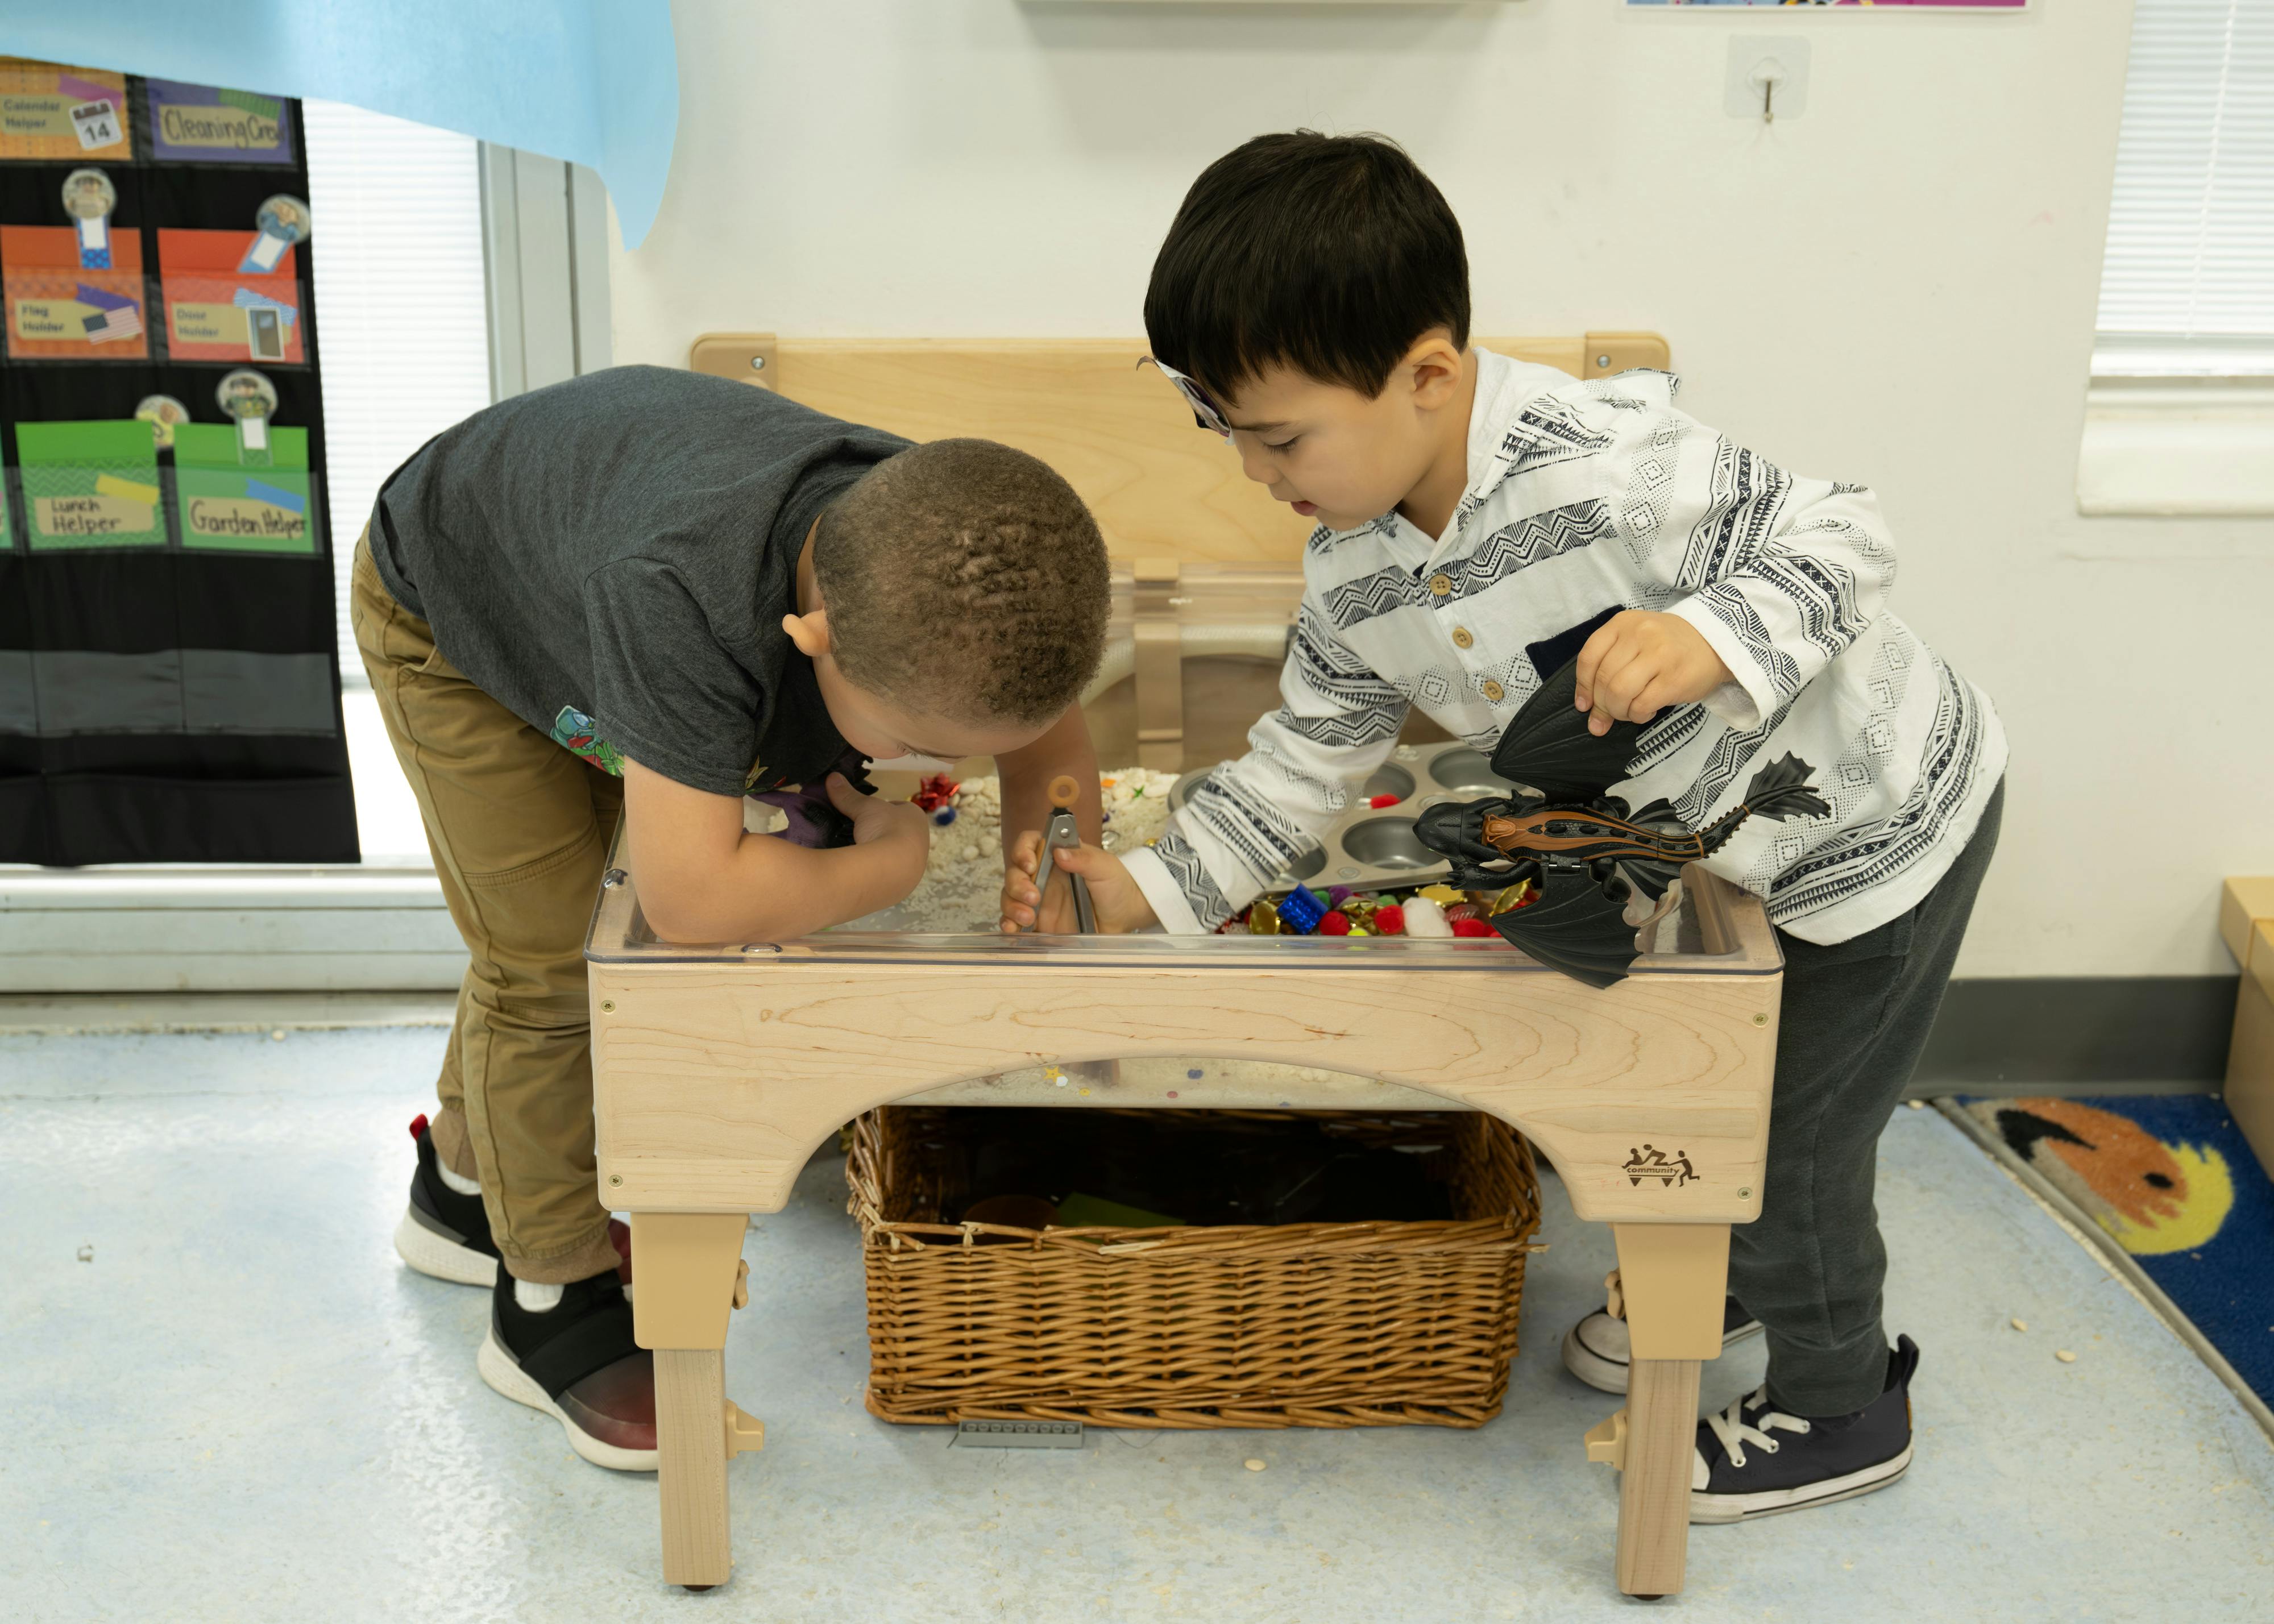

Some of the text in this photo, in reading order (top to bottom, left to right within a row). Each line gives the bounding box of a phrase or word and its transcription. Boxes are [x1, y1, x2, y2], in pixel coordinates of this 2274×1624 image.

[3, 98, 60, 112] Calendar
[6, 118, 46, 128] Helper
[85, 121, 110, 142] 14
[22, 304, 49, 317] Flag
[176, 308, 206, 320] Door
[23, 321, 64, 333] Holder
[179, 326, 219, 337] Holder
[51, 497, 101, 512] Lunch
[52, 514, 121, 535] Helper
[190, 500, 307, 539] Garden Helper
[1627, 1166, 1679, 1176] community
